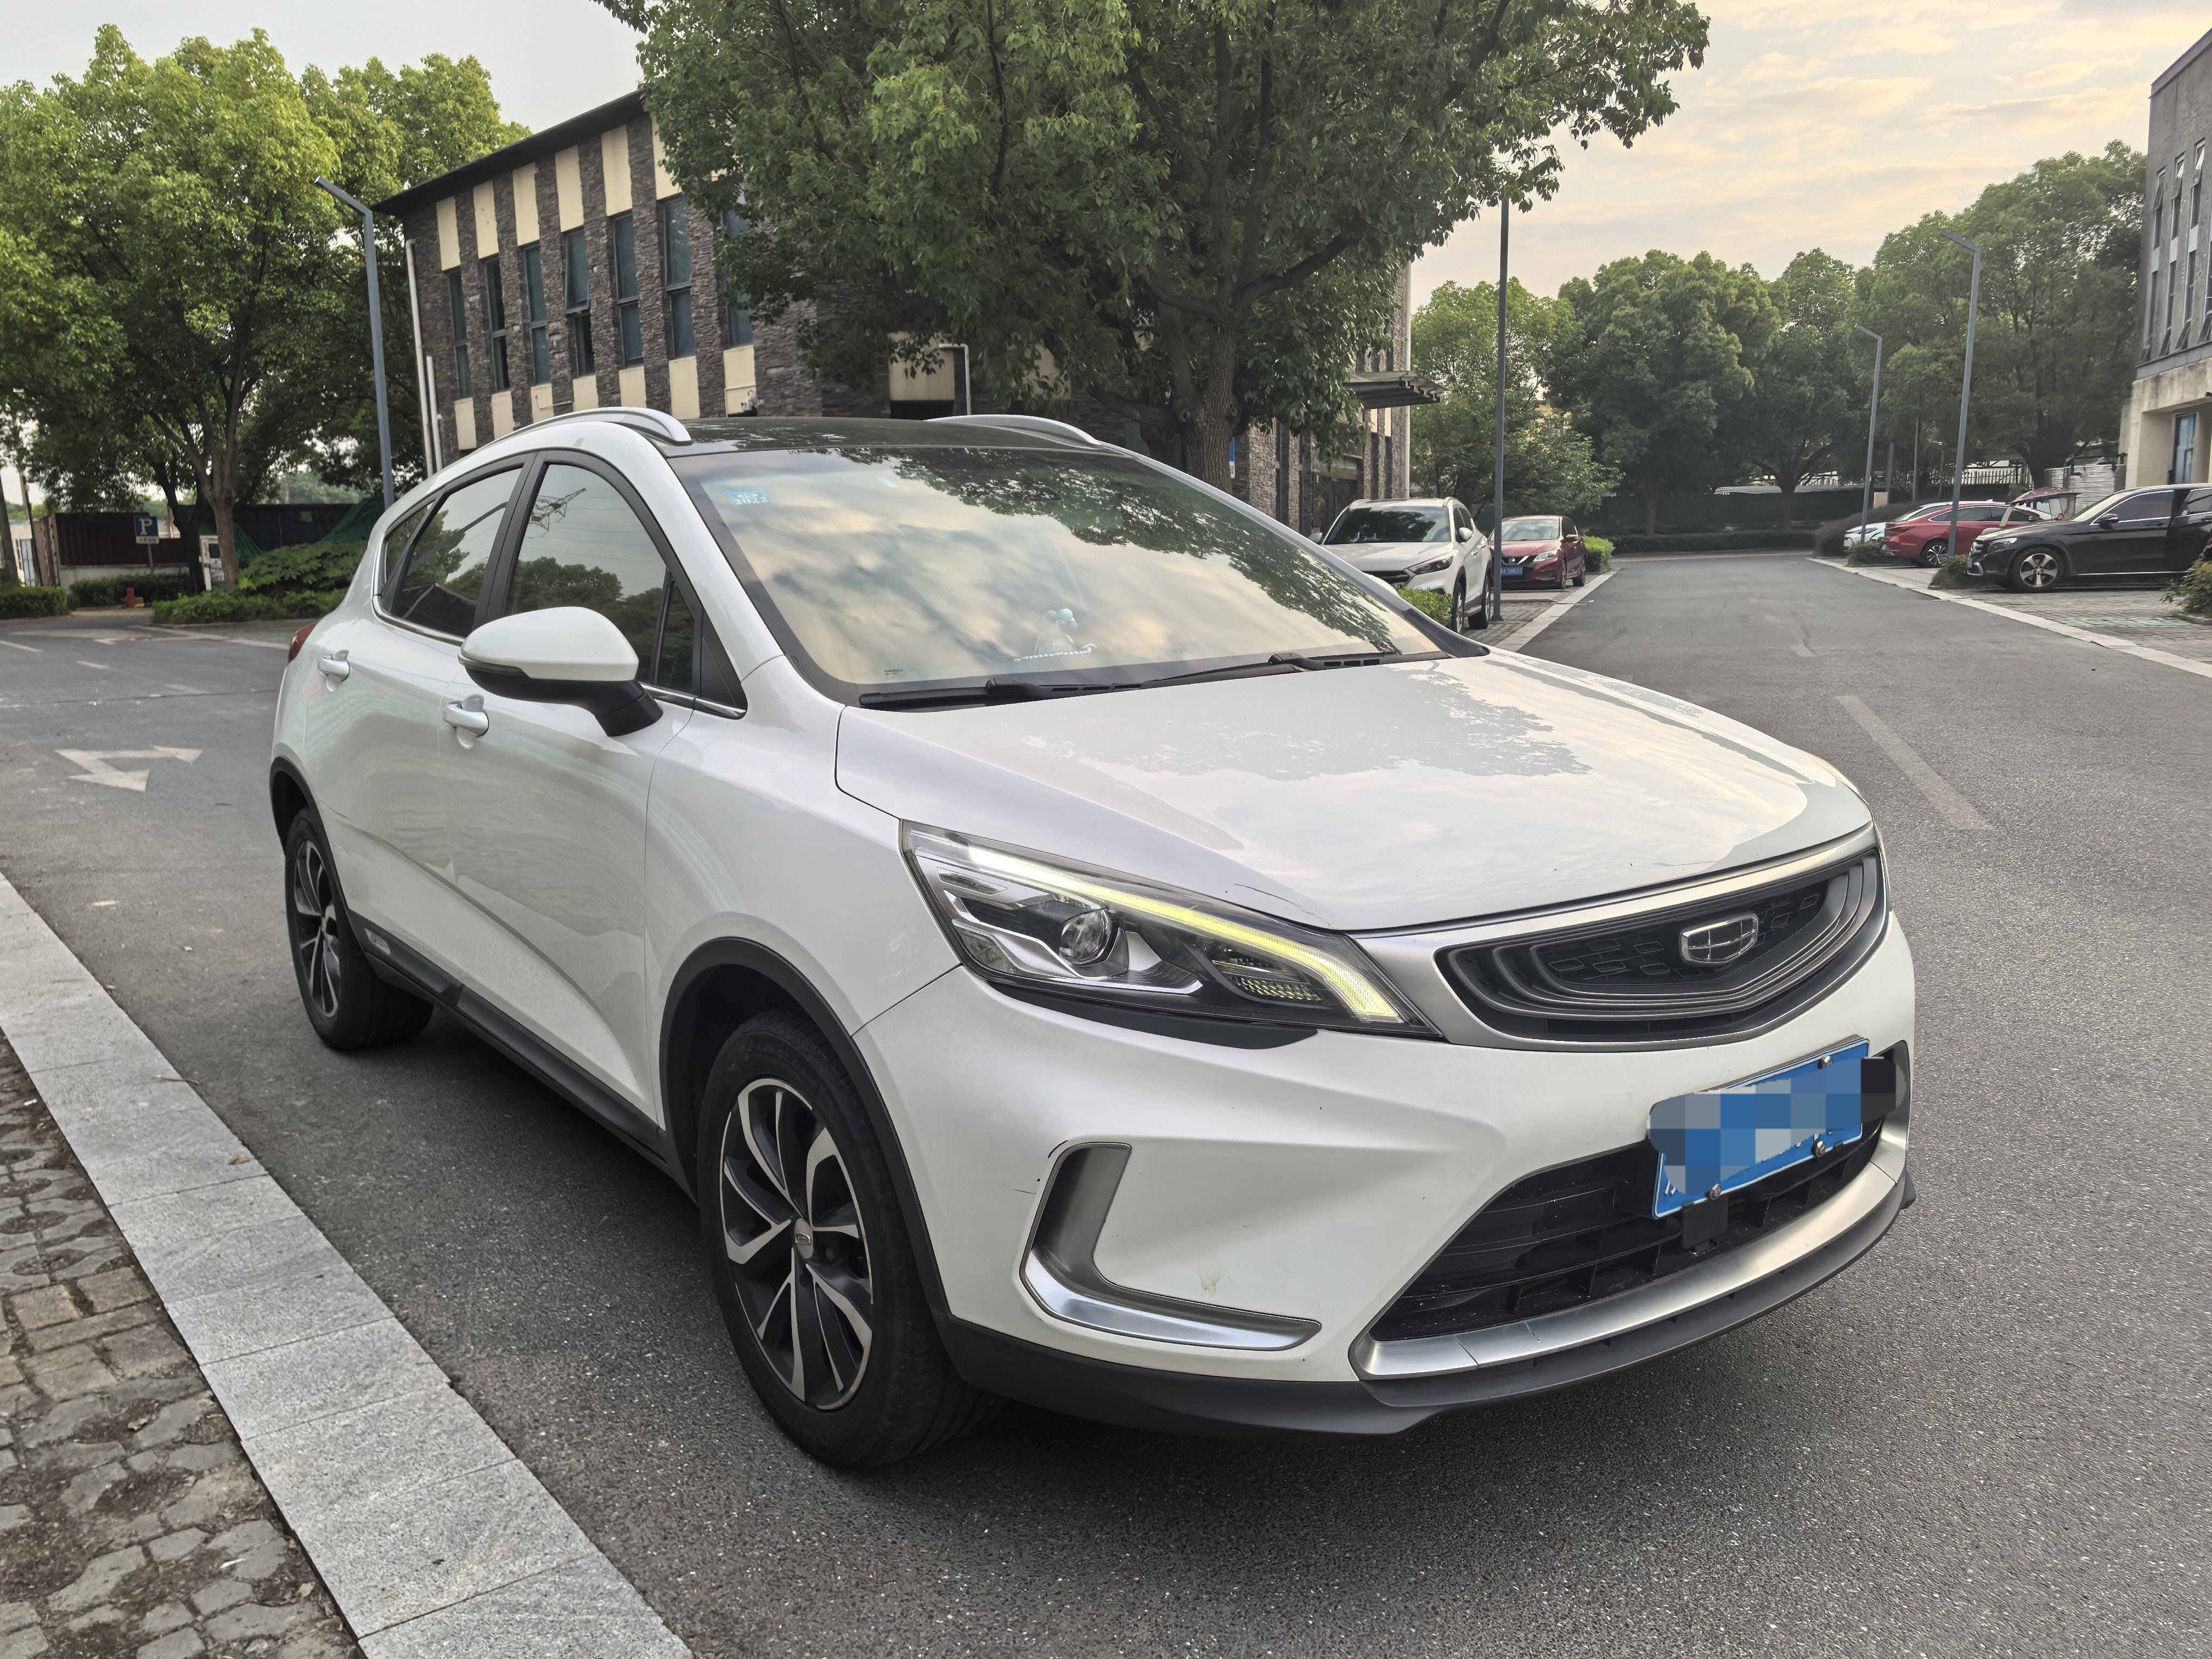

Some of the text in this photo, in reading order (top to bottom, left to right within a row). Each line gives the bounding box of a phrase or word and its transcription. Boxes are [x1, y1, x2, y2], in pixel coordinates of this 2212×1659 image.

[734, 496, 768, 505] 2022
[139, 518, 152, 535] P
[956, 878, 977, 886] GEELY
